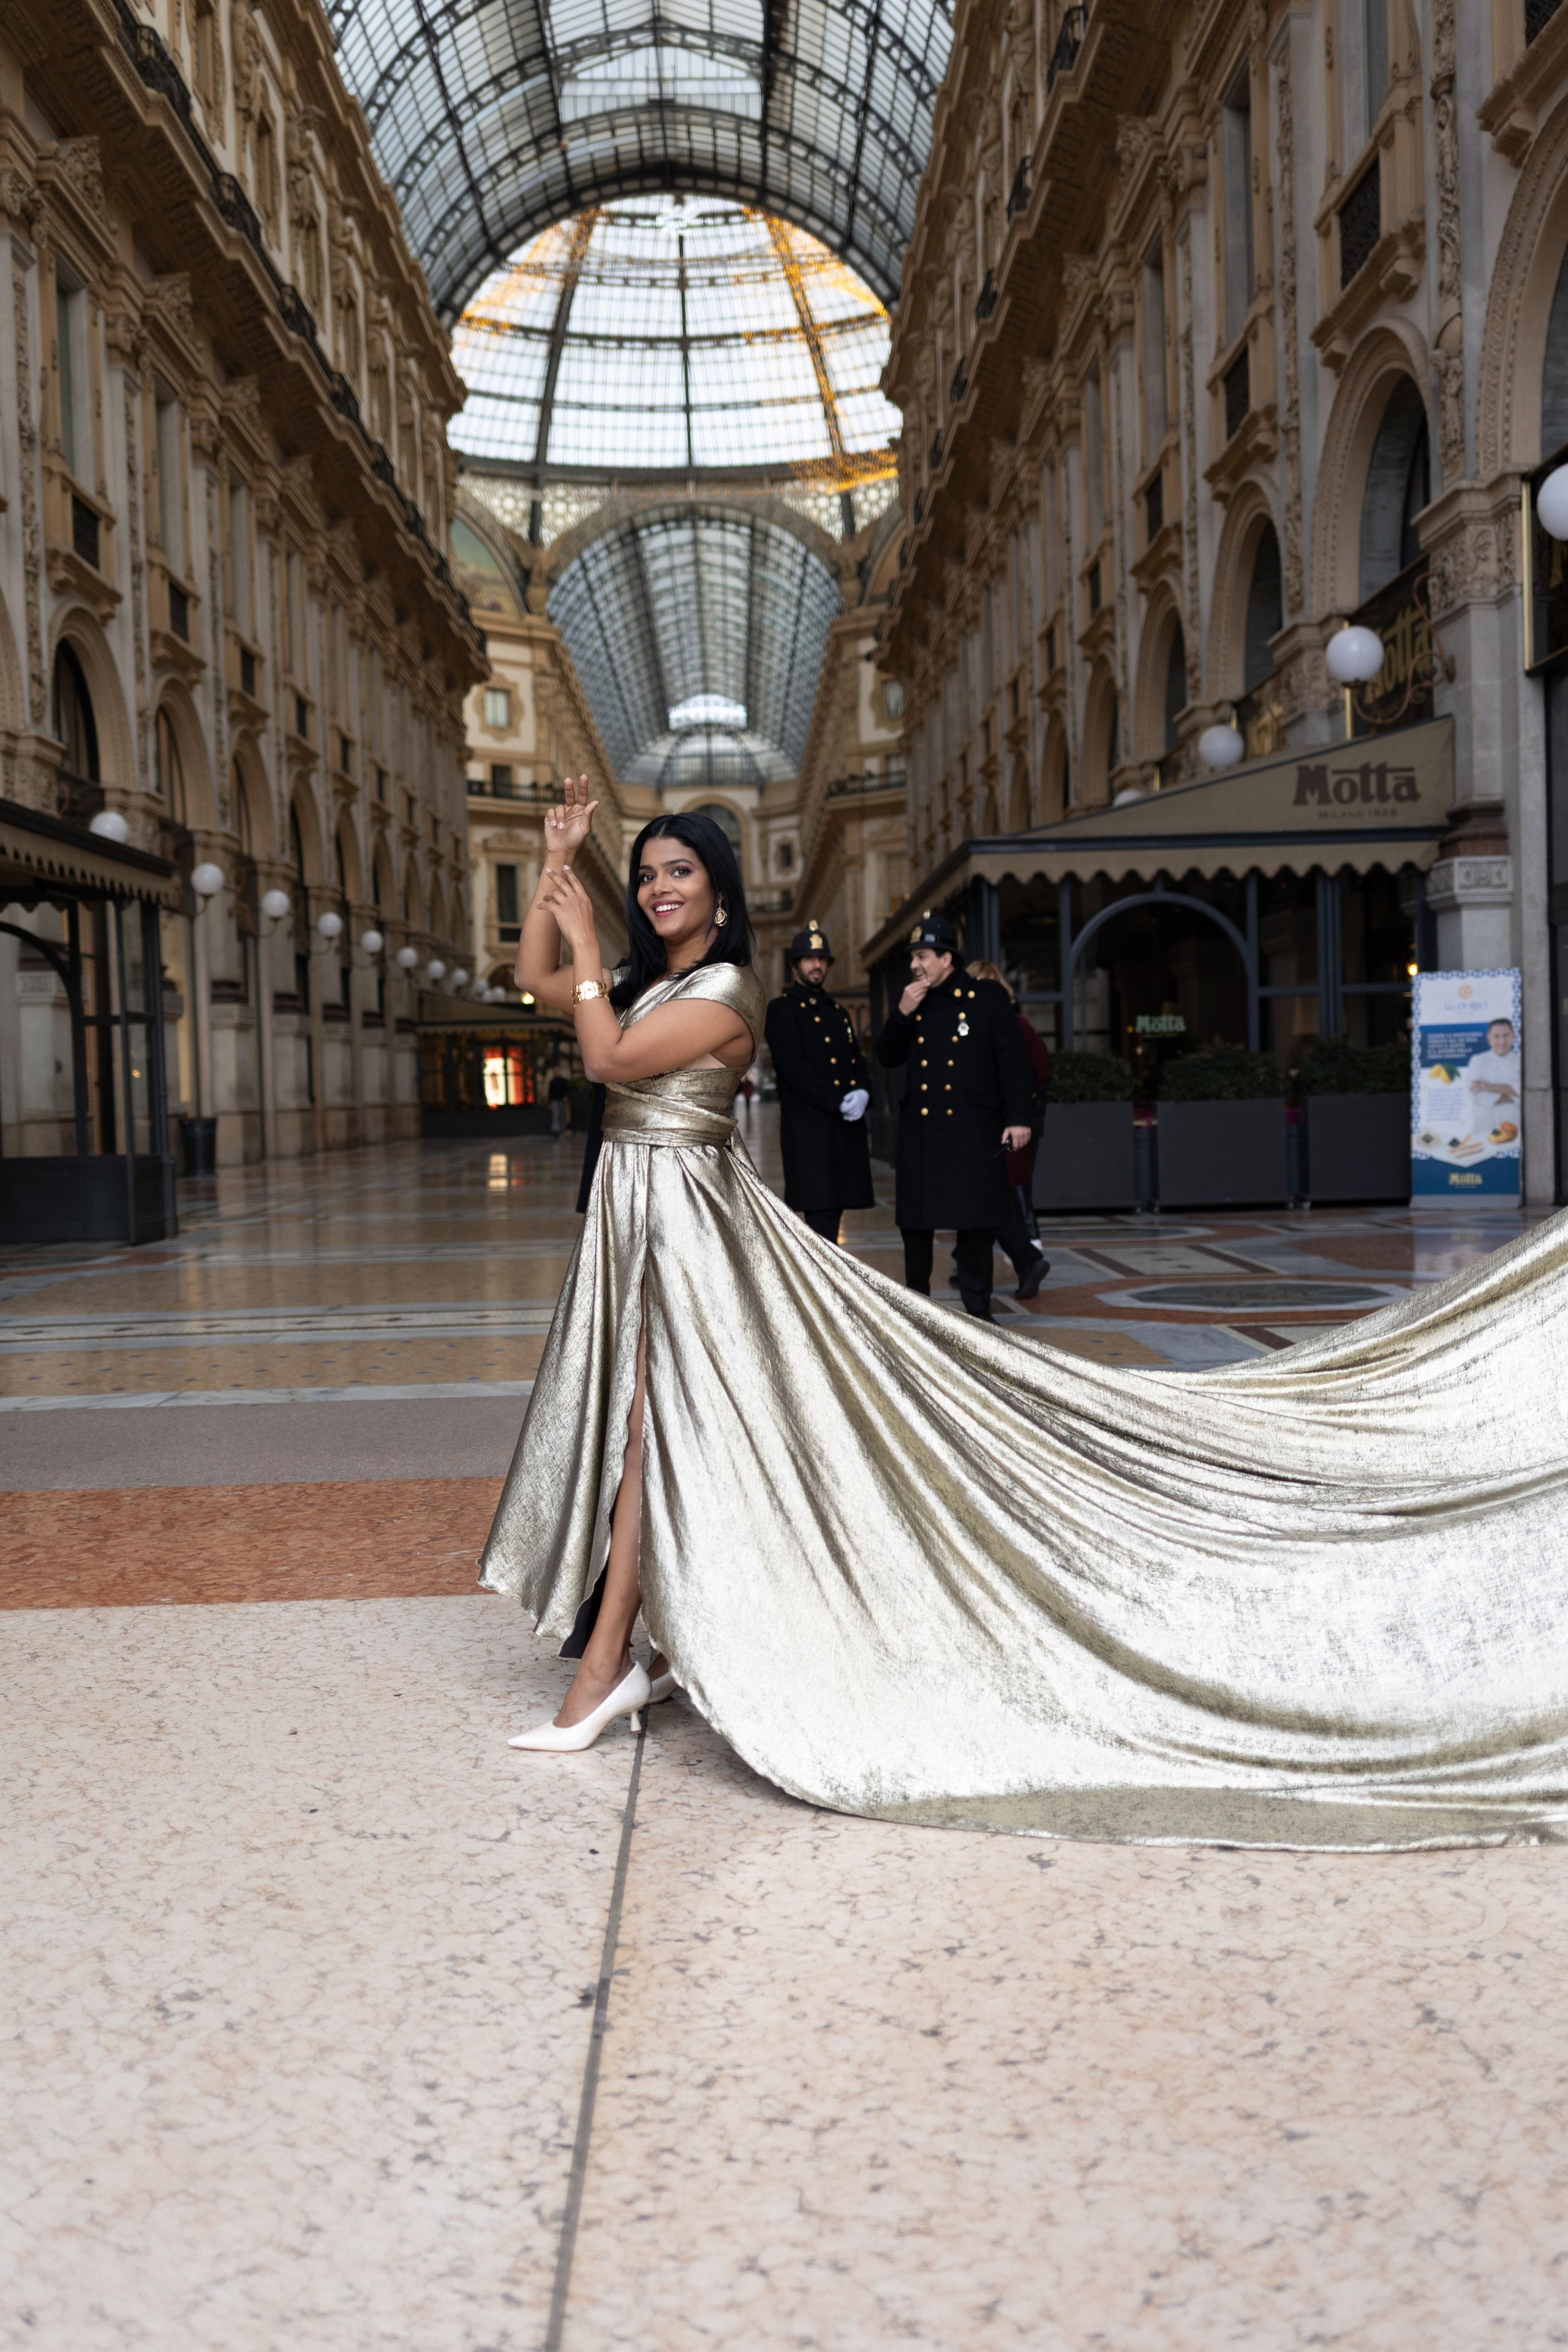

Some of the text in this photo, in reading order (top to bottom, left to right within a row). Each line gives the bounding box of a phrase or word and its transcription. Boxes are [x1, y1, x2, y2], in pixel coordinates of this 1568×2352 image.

[1294, 761, 1421, 805] Motta
[1136, 1014, 1186, 1033] Motta
[1449, 1172, 1482, 1185] Motta
